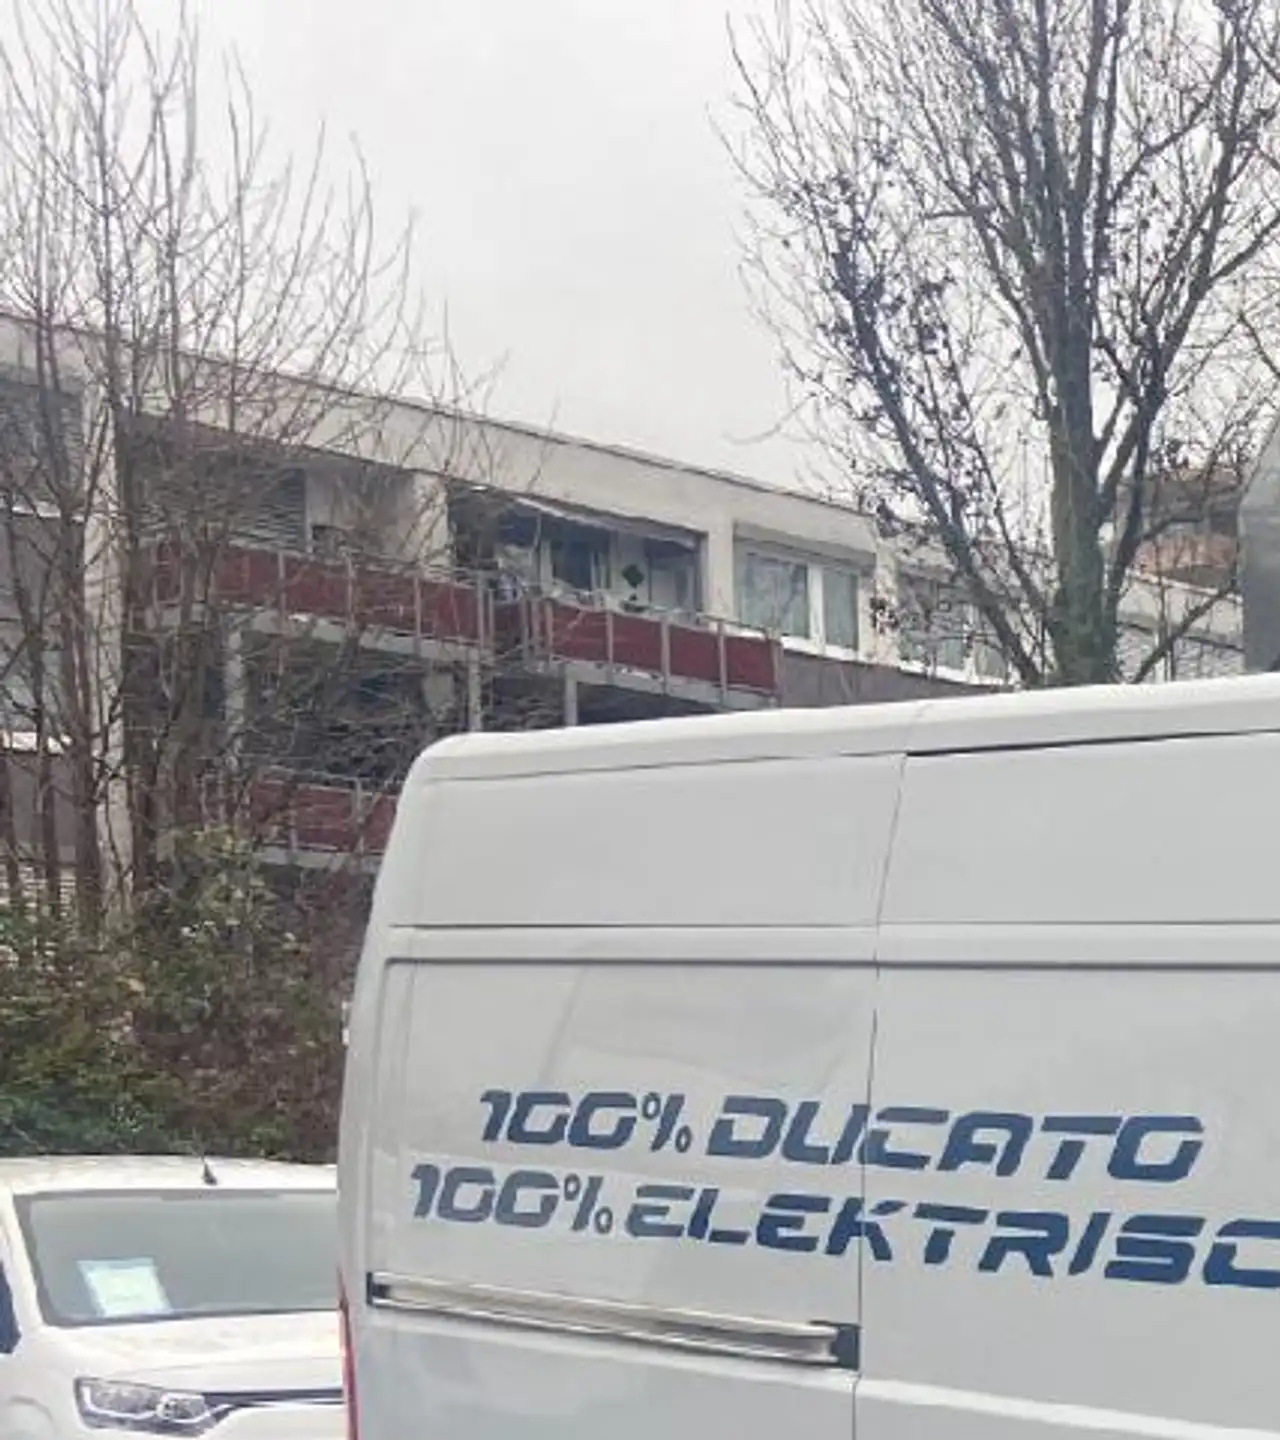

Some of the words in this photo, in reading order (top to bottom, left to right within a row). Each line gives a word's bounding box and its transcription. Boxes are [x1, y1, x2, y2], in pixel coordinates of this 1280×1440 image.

[481, 1091, 692, 1154] 100%
[708, 1096, 1203, 1183] DUCATO
[411, 1163, 613, 1235] 100%
